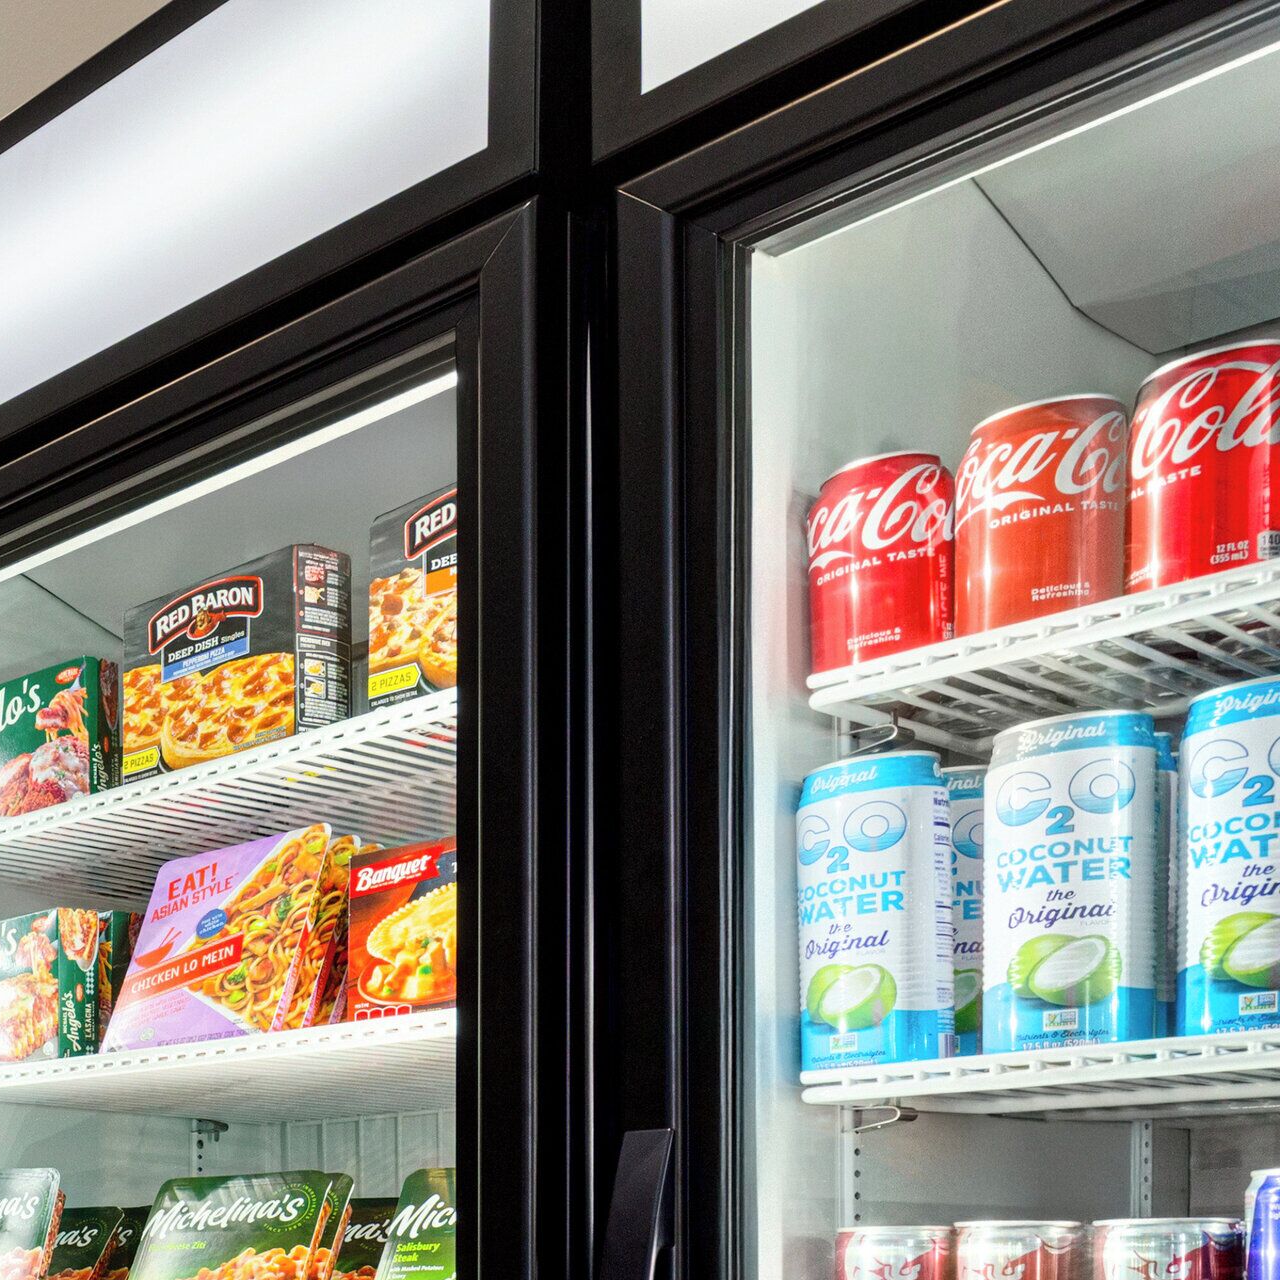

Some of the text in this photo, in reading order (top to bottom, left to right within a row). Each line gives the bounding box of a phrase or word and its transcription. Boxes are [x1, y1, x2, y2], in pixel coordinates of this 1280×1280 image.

[414, 502, 457, 547] RED
[990, 499, 1119, 529] ORIGINAL TASTE
[1210, 551, 1249, 565] (355 mL)
[1216, 540, 1249, 553] 12 FL OZ
[816, 546, 936, 586] ORIGINAL TASTE
[1031, 582, 1081, 596] Delicious
[1031, 587, 1090, 602] Refreshing
[156, 586, 254, 641] RED BARON
[168, 645, 194, 663] DEEP
[194, 636, 220, 656] DISH
[221, 630, 245, 644] Singles
[847, 626, 901, 645] Delicious &
[848, 634, 901, 651] Refreshing
[371, 671, 412, 691] 2 PIZZAS
[1214, 689, 1280, 724] Origin
[1018, 721, 1106, 748] Original
[130, 754, 154, 768] PIZZAS
[811, 765, 879, 794] Original
[996, 835, 1133, 870] COCONUT
[168, 862, 218, 901] EAT!
[355, 855, 432, 892] Banquet
[798, 870, 906, 903] COCONUT
[996, 857, 1132, 893] WATER
[1242, 864, 1275, 879] the
[151, 898, 189, 923] ASIAN
[191, 877, 234, 906] STYLE
[799, 890, 905, 926] WATER
[1046, 889, 1076, 902] the
[1008, 900, 1117, 929] Original
[805, 930, 889, 960] Original
[131, 945, 235, 994] CHICKEN LO MEIN
[141, 1194, 305, 1241] Michelina's
[393, 1252, 419, 1263] Steak
[396, 1242, 441, 1254] Salisbury
